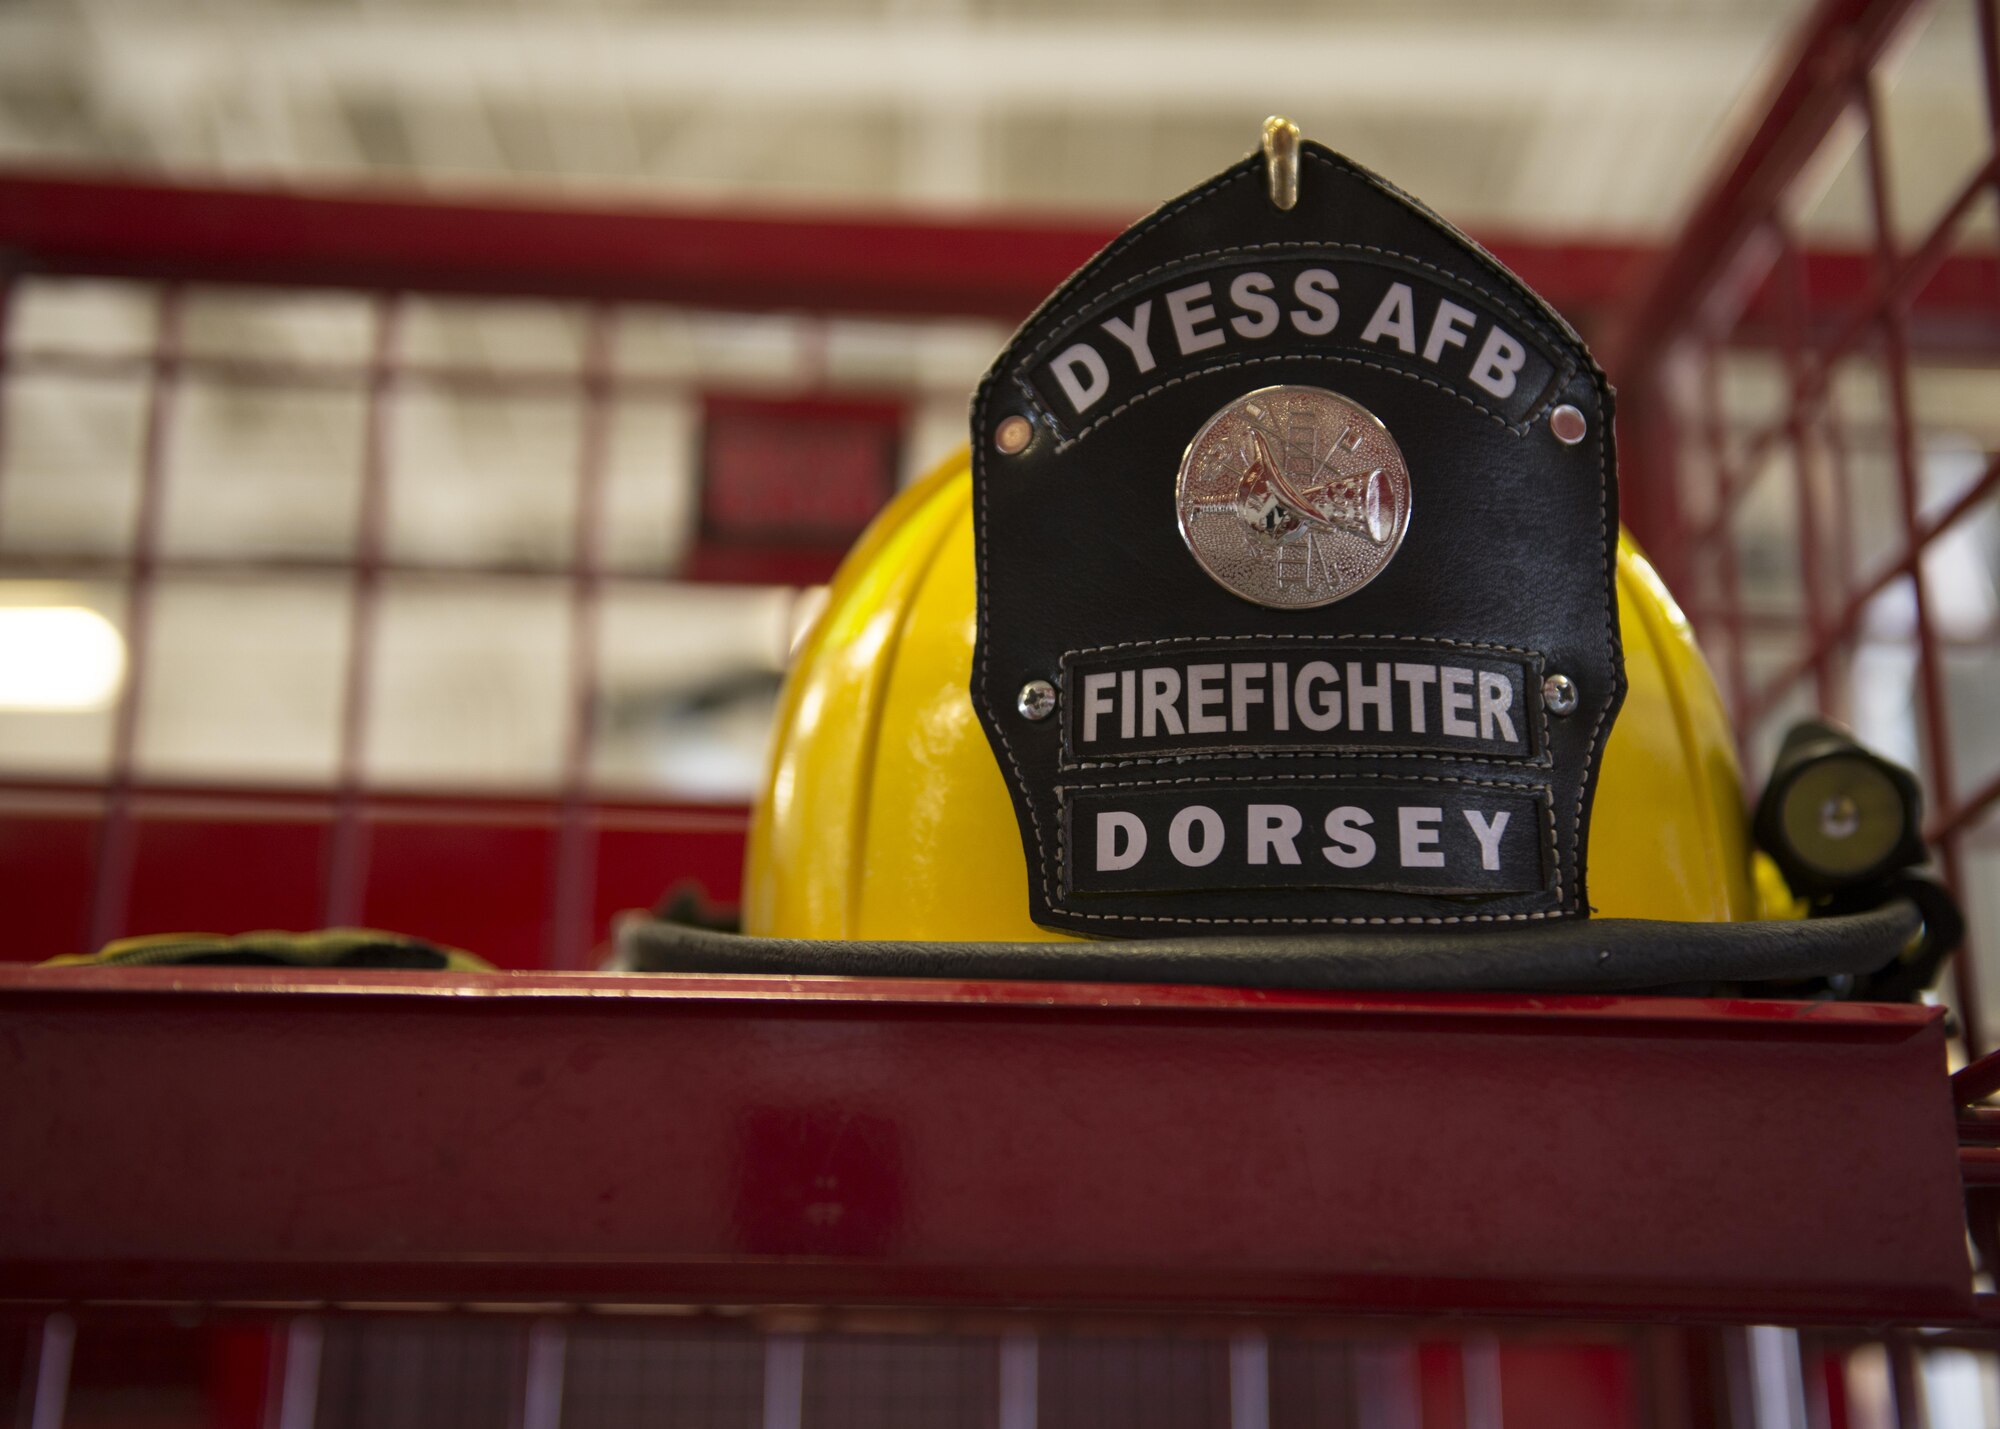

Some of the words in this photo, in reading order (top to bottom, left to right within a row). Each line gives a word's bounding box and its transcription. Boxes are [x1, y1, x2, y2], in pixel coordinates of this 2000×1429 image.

[1049, 267, 1342, 415] DYESS
[1360, 283, 1527, 400] AFB
[1082, 661, 1520, 744] FIREFIGHTER
[1095, 803, 1512, 872] DORSEY
